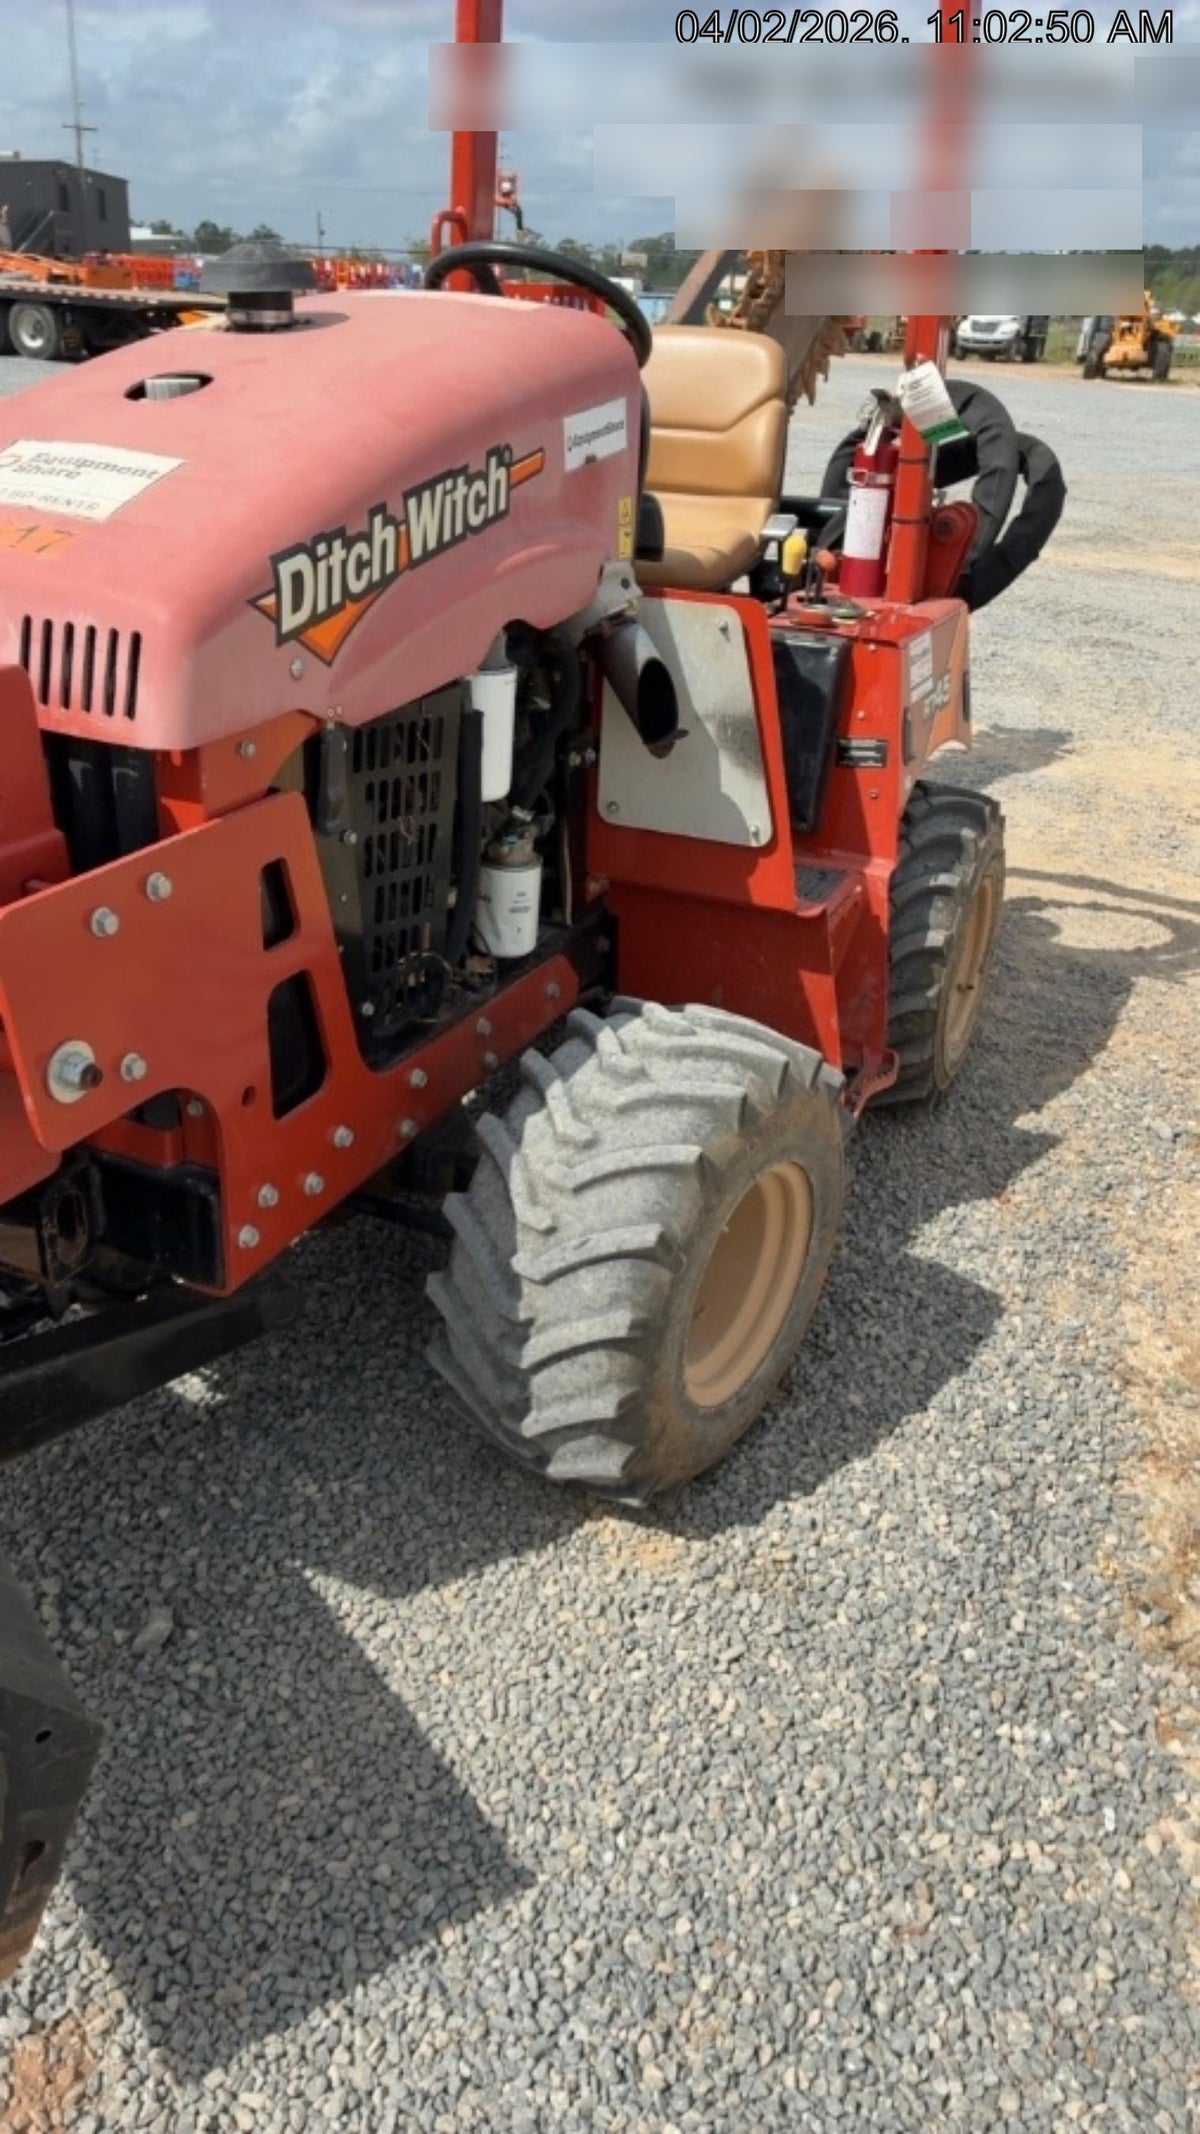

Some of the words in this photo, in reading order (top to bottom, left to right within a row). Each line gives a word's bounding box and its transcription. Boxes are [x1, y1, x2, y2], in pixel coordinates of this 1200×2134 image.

[31, 452, 160, 479] Equipment
[276, 512, 397, 635] Ditch
[406, 455, 508, 562] Witch
